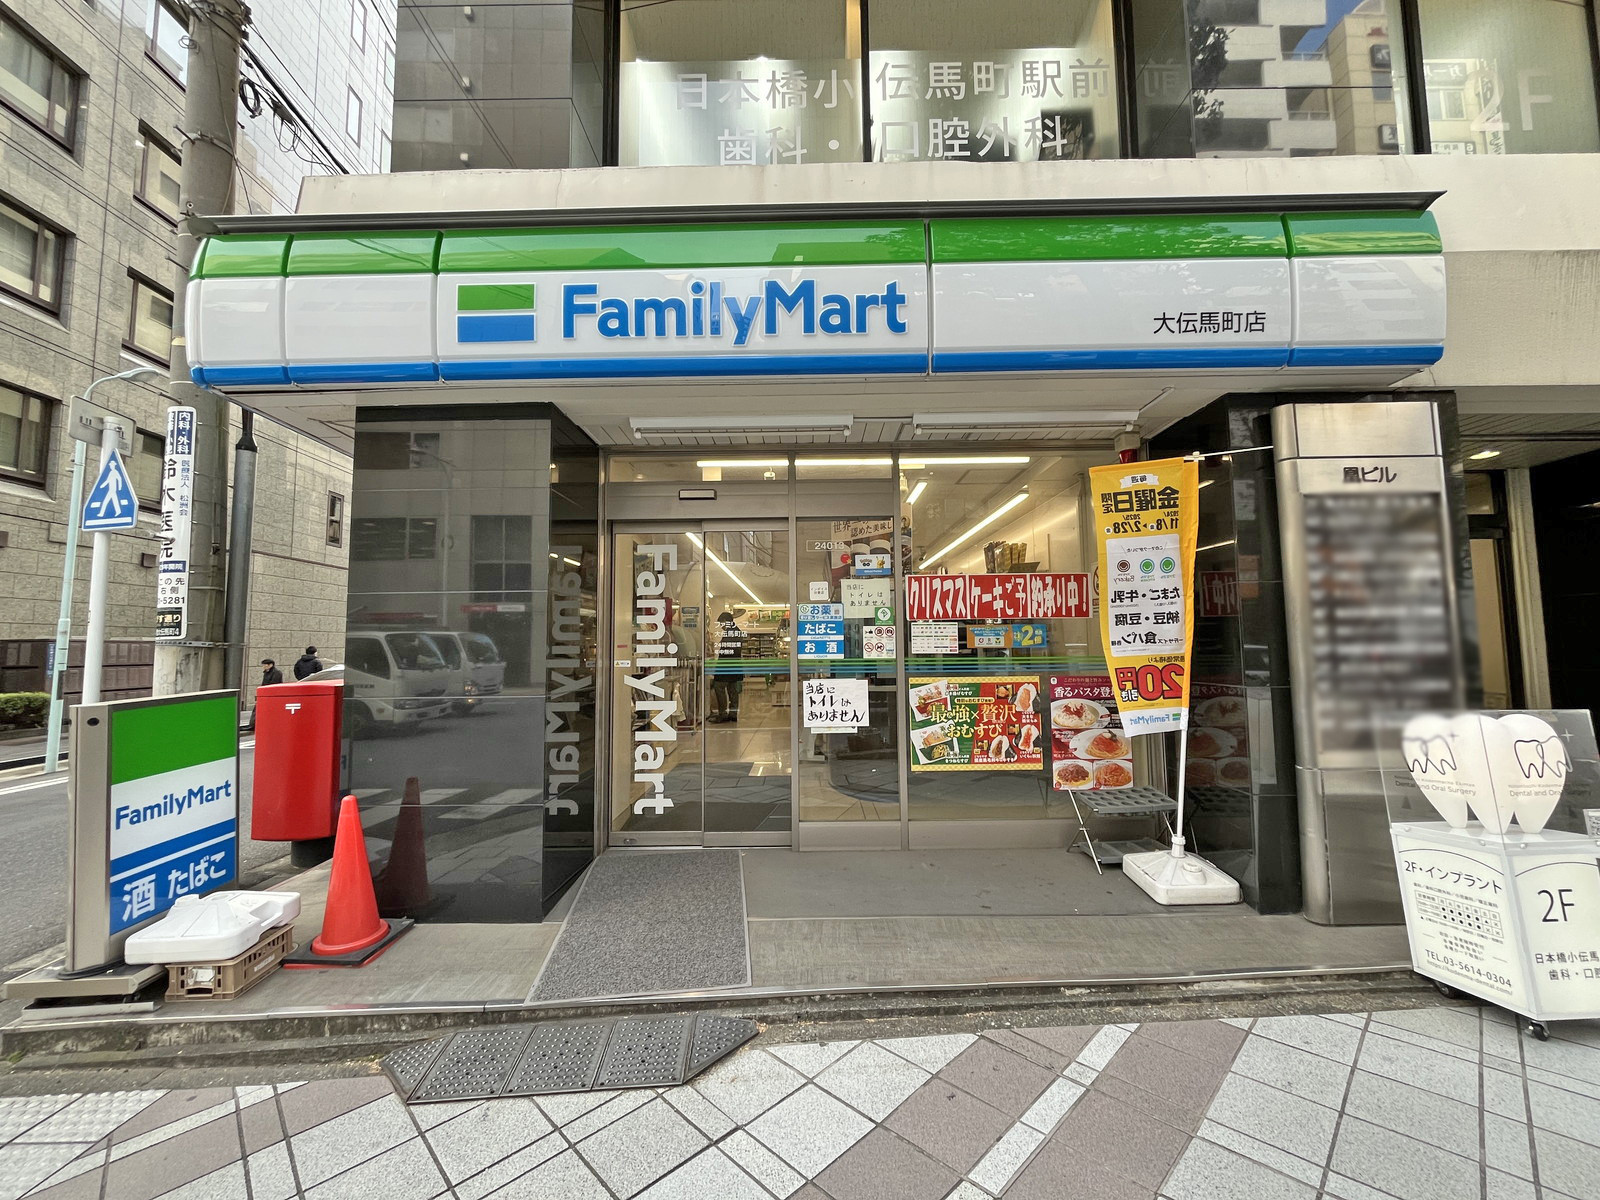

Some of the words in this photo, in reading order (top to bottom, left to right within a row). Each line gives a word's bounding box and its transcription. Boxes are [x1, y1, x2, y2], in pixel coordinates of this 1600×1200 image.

[676, 58, 1111, 111] 日本橋小伝馬町駅前
[717, 115, 1068, 166] 歯科・口腔外科
[562, 279, 908, 346] FamilyMart
[1153, 311, 1267, 334] 大伝馬町店
[177, 411, 191, 454] 内科・外科
[810, 604, 832, 615] お薬
[804, 623, 837, 634] たばこ
[624, 544, 678, 816] FamilyMart
[806, 683, 836, 694] 当店に
[809, 695, 852, 707] トイレは
[807, 709, 865, 723] ありません
[947, 723, 1003, 738] おむすび
[1431, 784, 1447, 793] Oral
[1447, 786, 1477, 797] Surgery
[1509, 789, 1533, 797] Dental
[1534, 789, 1548, 797] and
[115, 780, 231, 830] FamilyMart
[122, 873, 156, 922] 酒
[167, 851, 226, 899] たばこ
[1537, 888, 1575, 923] 2F
